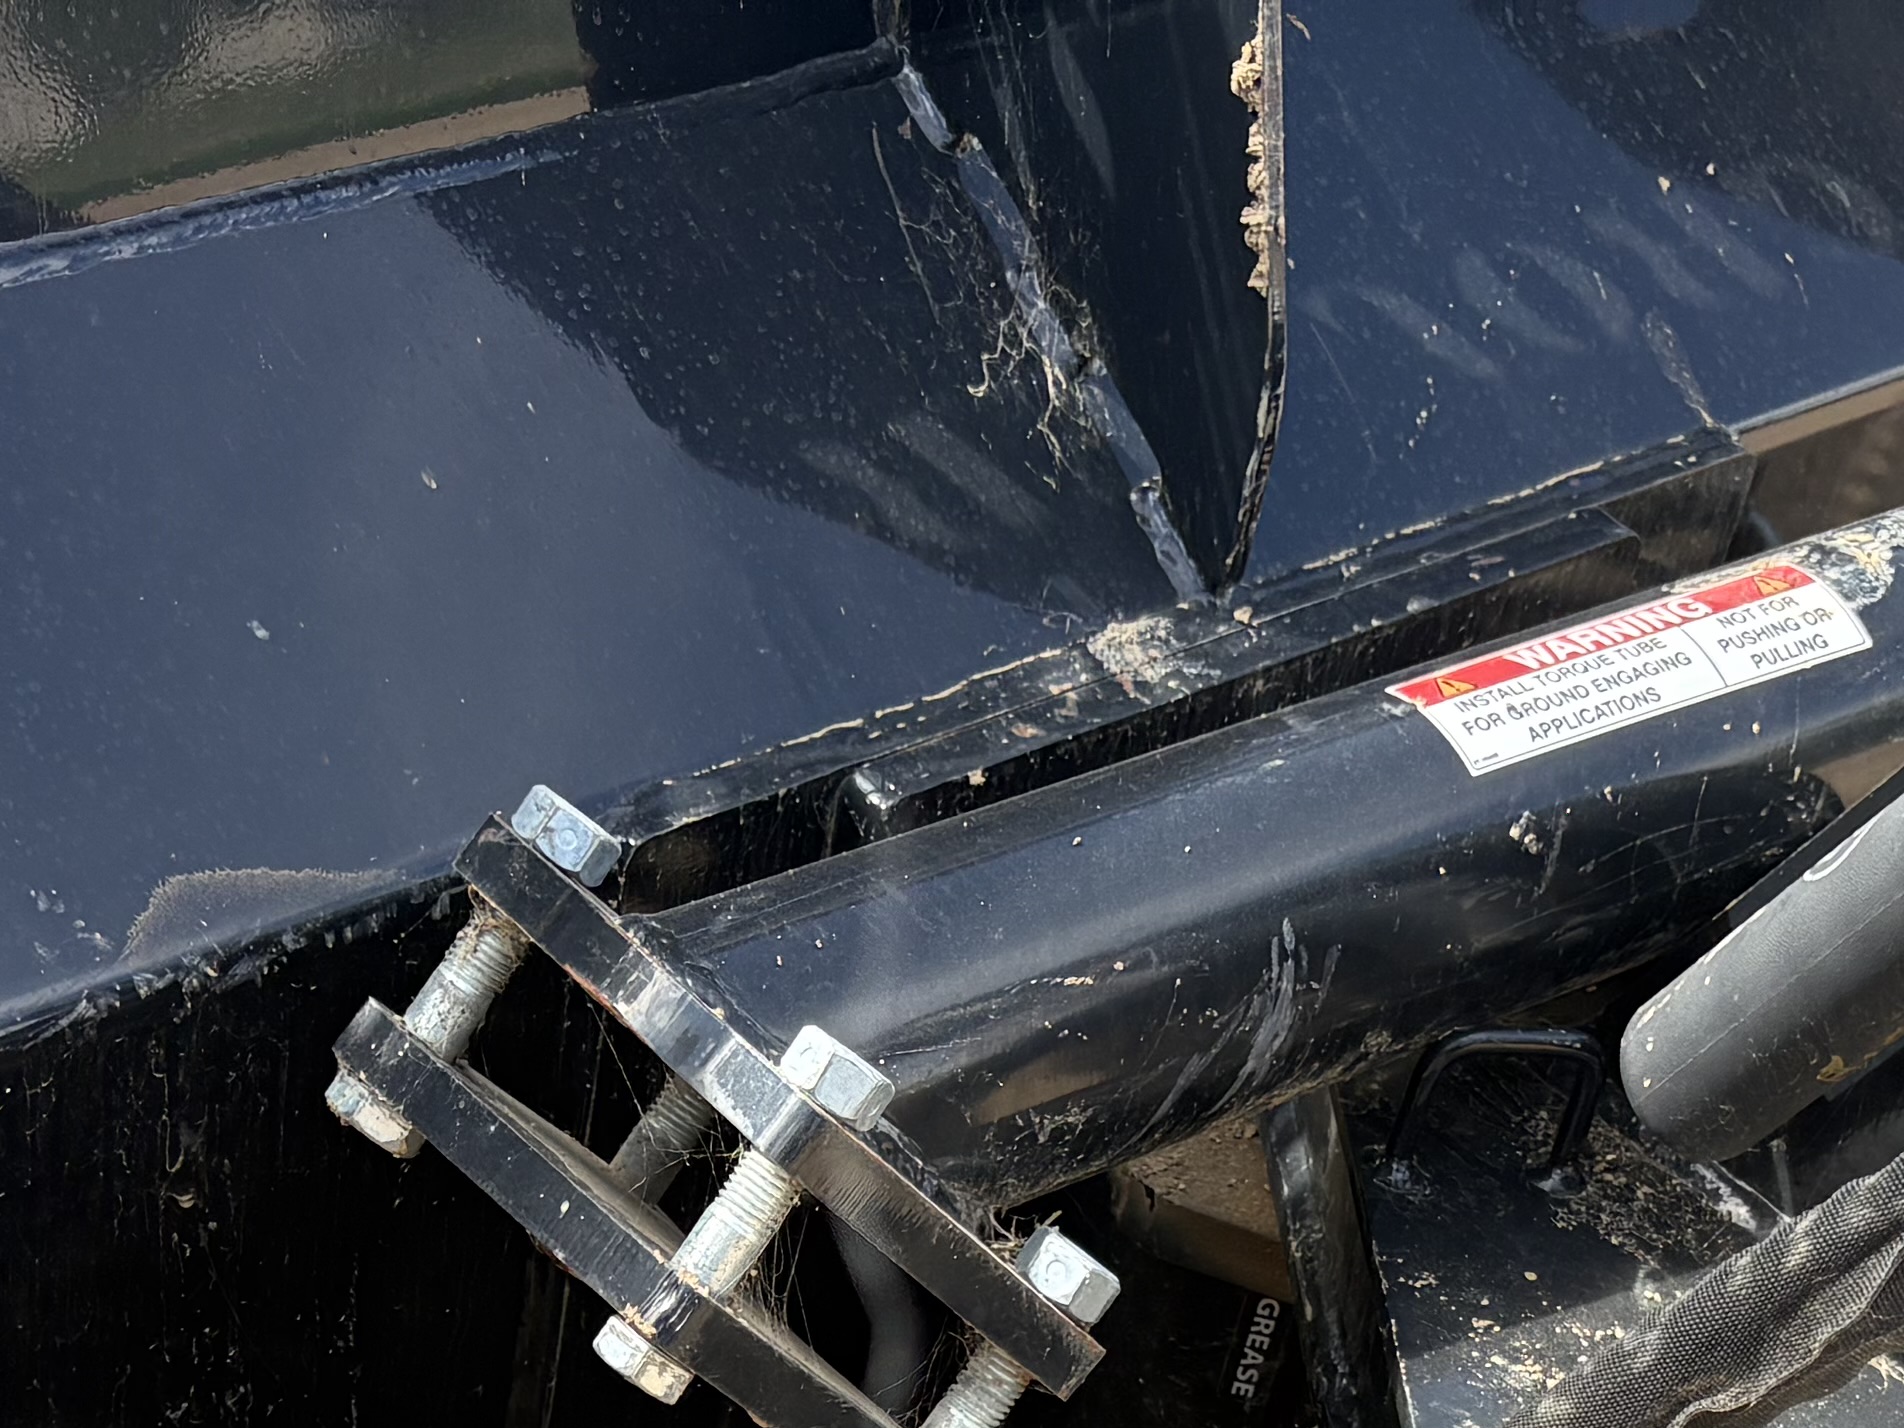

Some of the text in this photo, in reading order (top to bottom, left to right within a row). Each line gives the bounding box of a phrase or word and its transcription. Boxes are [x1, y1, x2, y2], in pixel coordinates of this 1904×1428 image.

[1498, 596, 1713, 670] WARNING
[1715, 596, 1800, 629] NOT FOR
[1716, 607, 1832, 654] PUSHING OR
[1453, 637, 1668, 713] INSTALL TORQUE TUBE
[1750, 633, 1829, 670] PULLING
[1461, 651, 1693, 736] FOR GROUND ENGAGING
[1528, 686, 1662, 743] APPLICATIONS
[1231, 1298, 1280, 1398] GREASE
